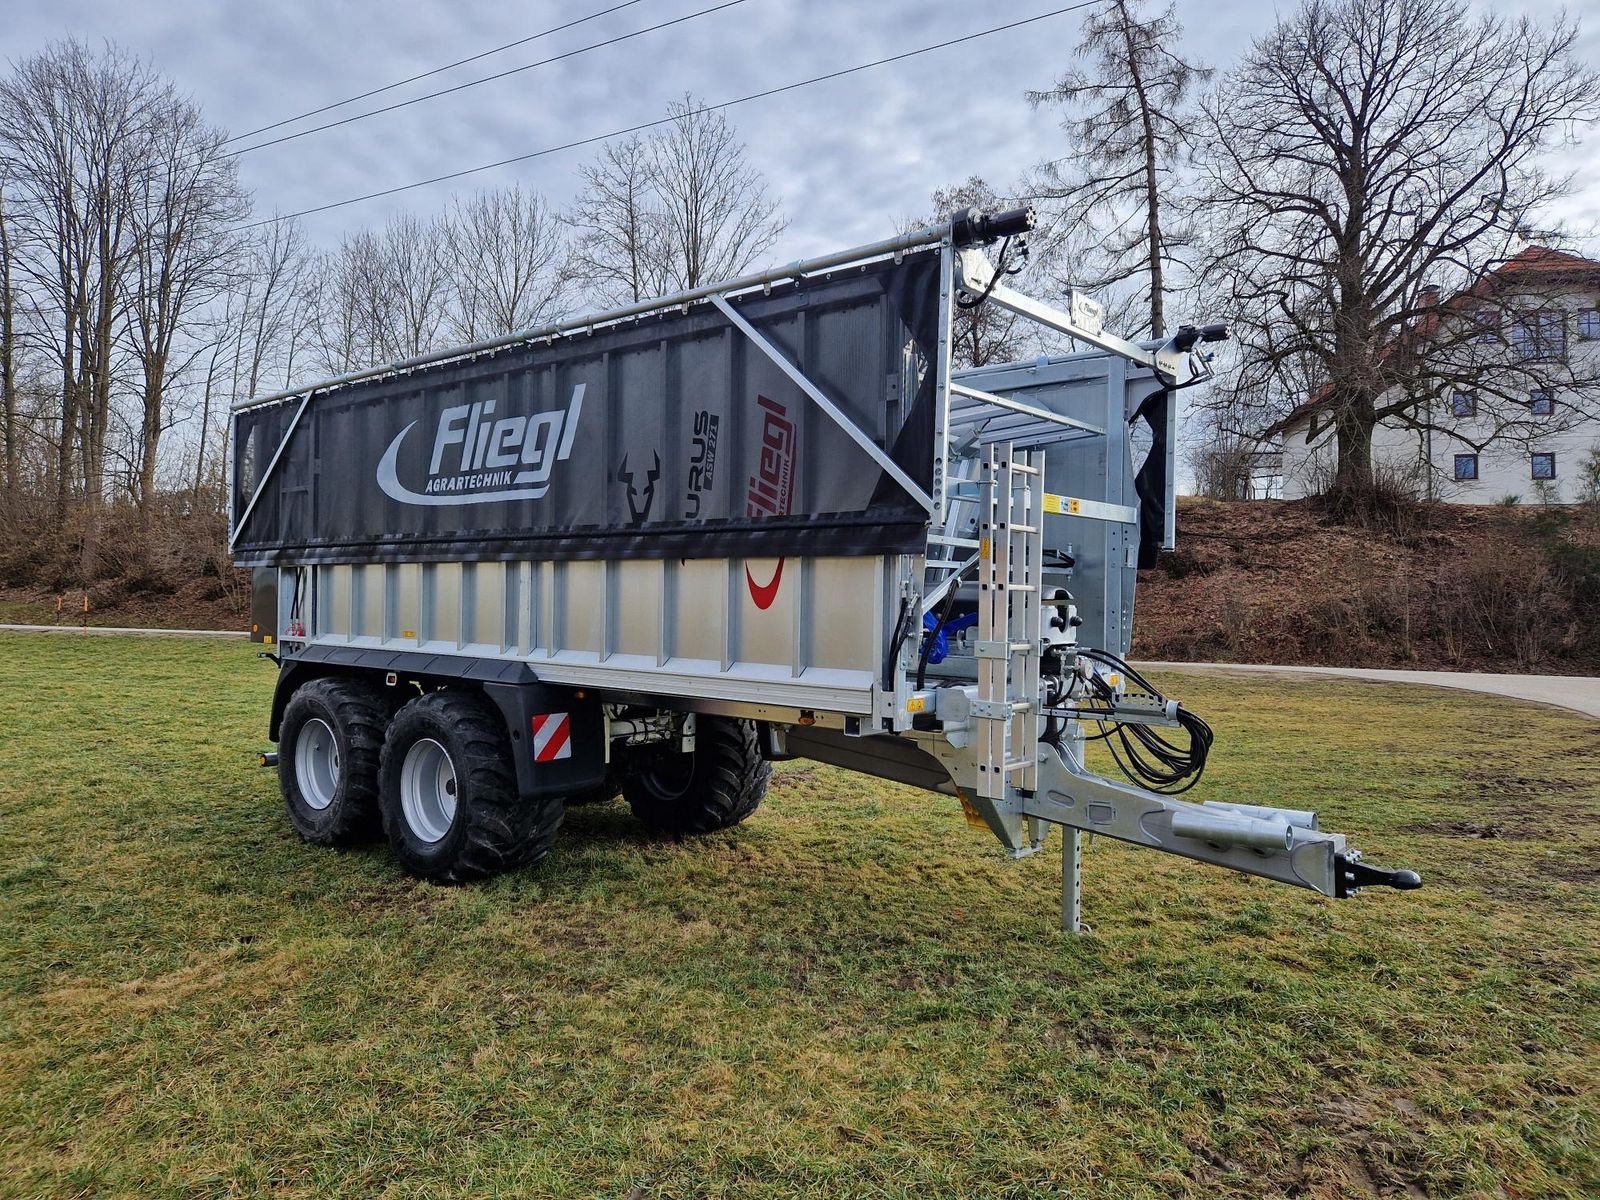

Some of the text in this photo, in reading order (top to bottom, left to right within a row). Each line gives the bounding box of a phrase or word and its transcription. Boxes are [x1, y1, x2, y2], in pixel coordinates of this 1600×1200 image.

[429, 383, 586, 484] Fliegl
[685, 410, 709, 519] URUS
[705, 424, 718, 480] ASW 271
[425, 471, 512, 493] AGRARTECHNIK
